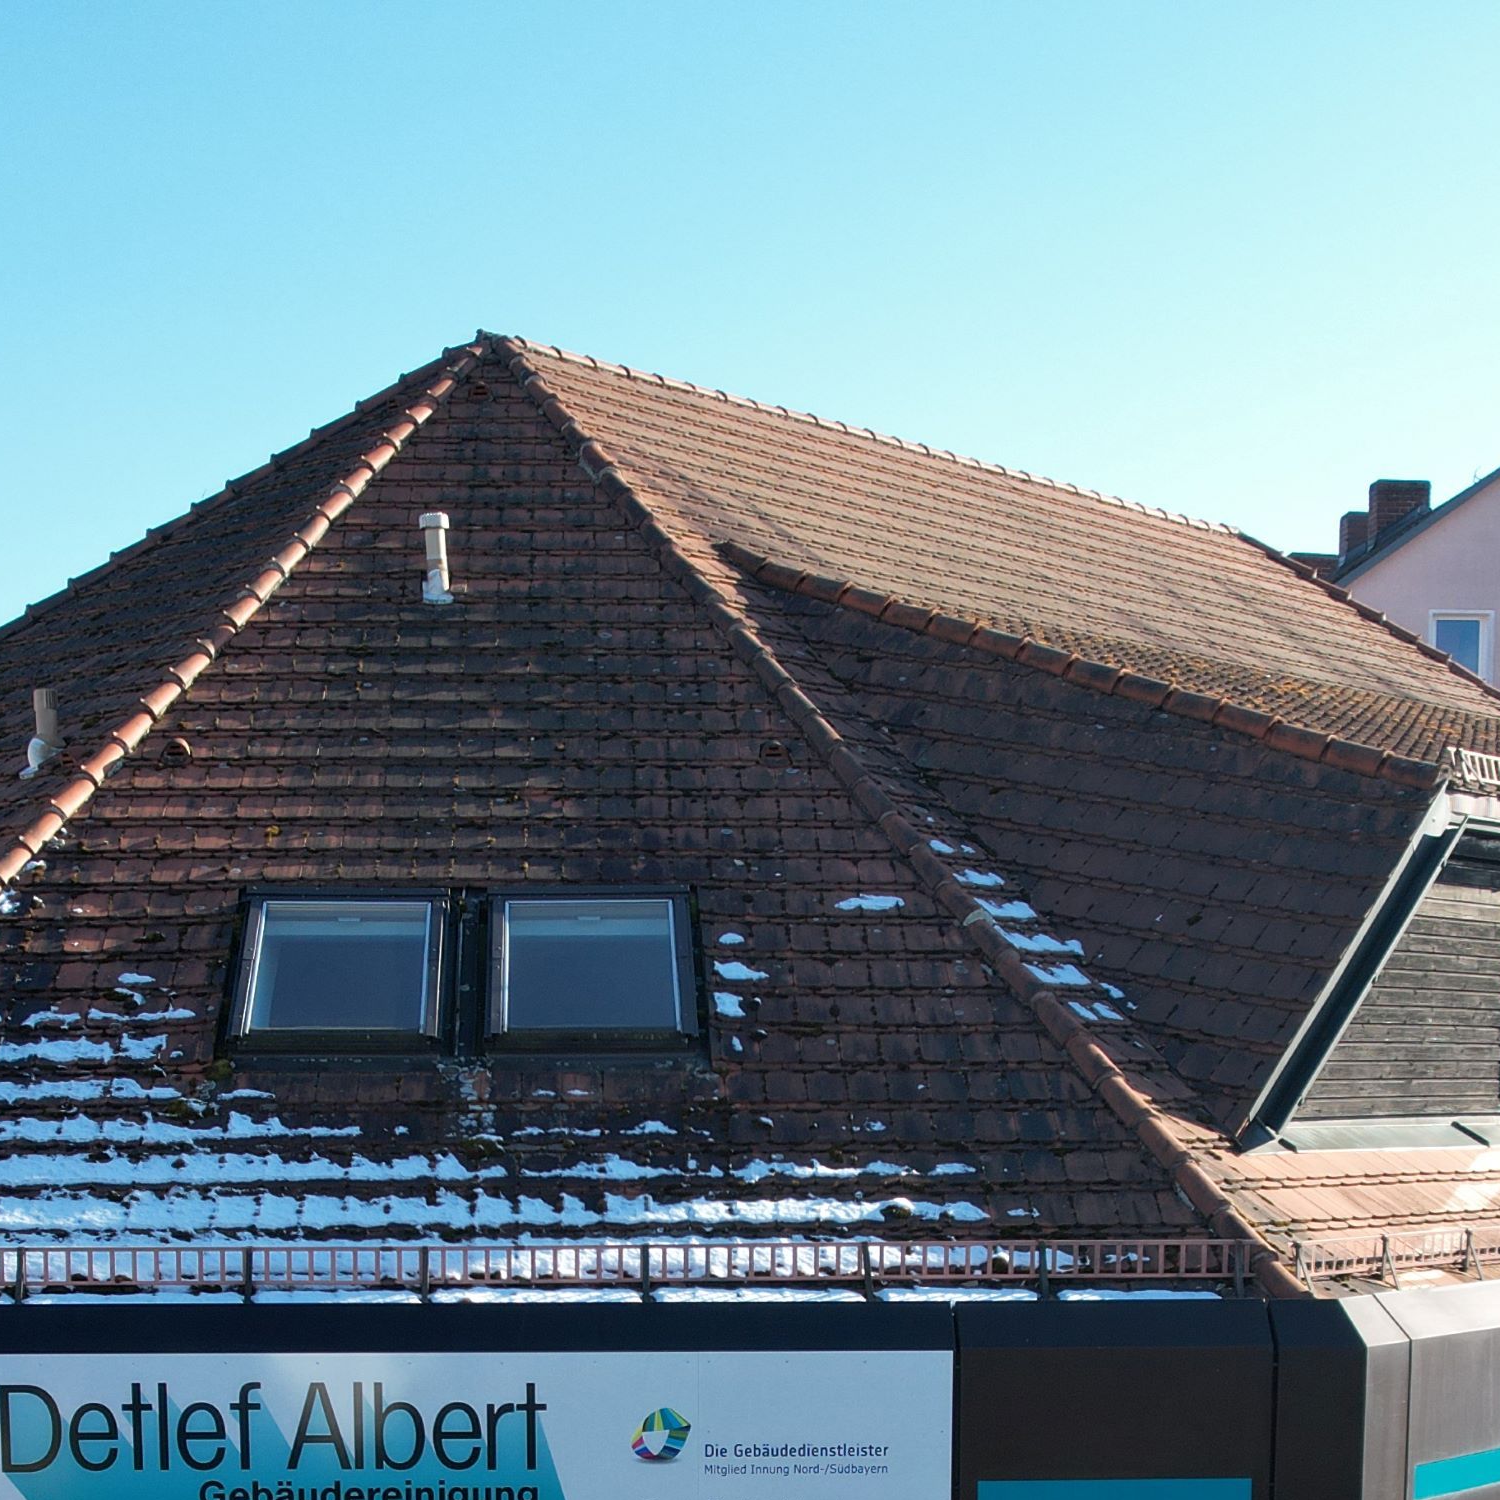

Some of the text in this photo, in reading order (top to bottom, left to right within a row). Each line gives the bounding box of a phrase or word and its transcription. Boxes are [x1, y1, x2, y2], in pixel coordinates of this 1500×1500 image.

[287, 1381, 548, 1472] Albert
[704, 1442, 889, 1458] Die Gebäudedienstleister
[704, 1463, 889, 1477] Mitglied Innung Nord-/Südbayern
